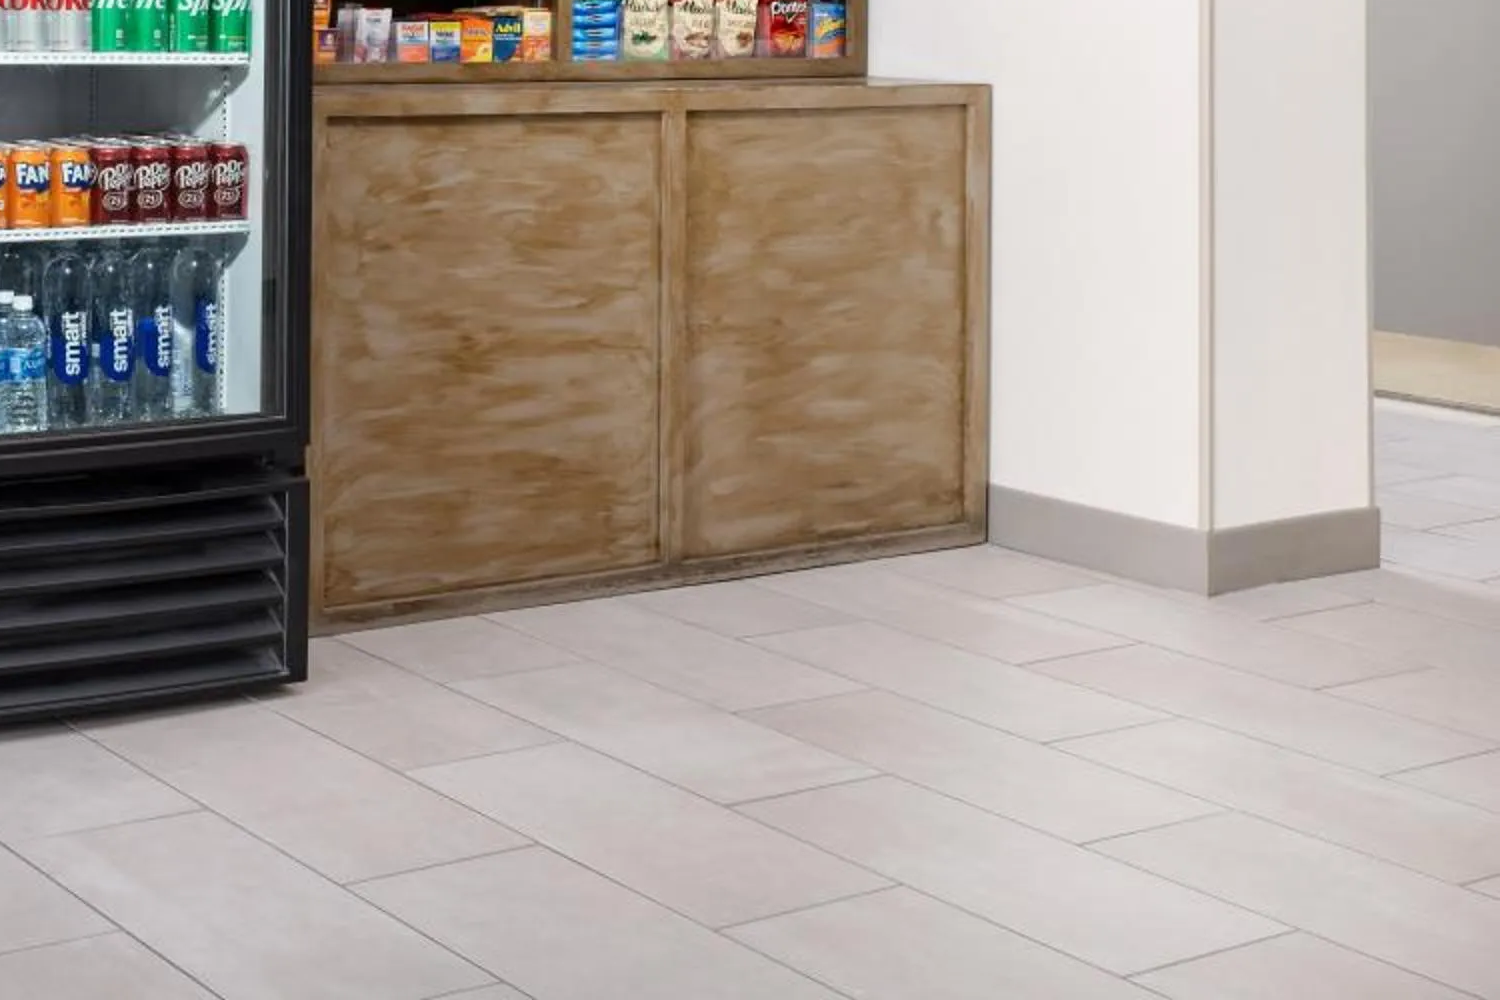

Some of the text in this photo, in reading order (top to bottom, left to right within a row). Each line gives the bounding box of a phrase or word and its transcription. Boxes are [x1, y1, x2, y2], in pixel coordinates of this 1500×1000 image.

[494, 22, 521, 34] Advil
[62, 311, 81, 376] smart
[109, 307, 129, 373] smart
[155, 304, 173, 369] smart
